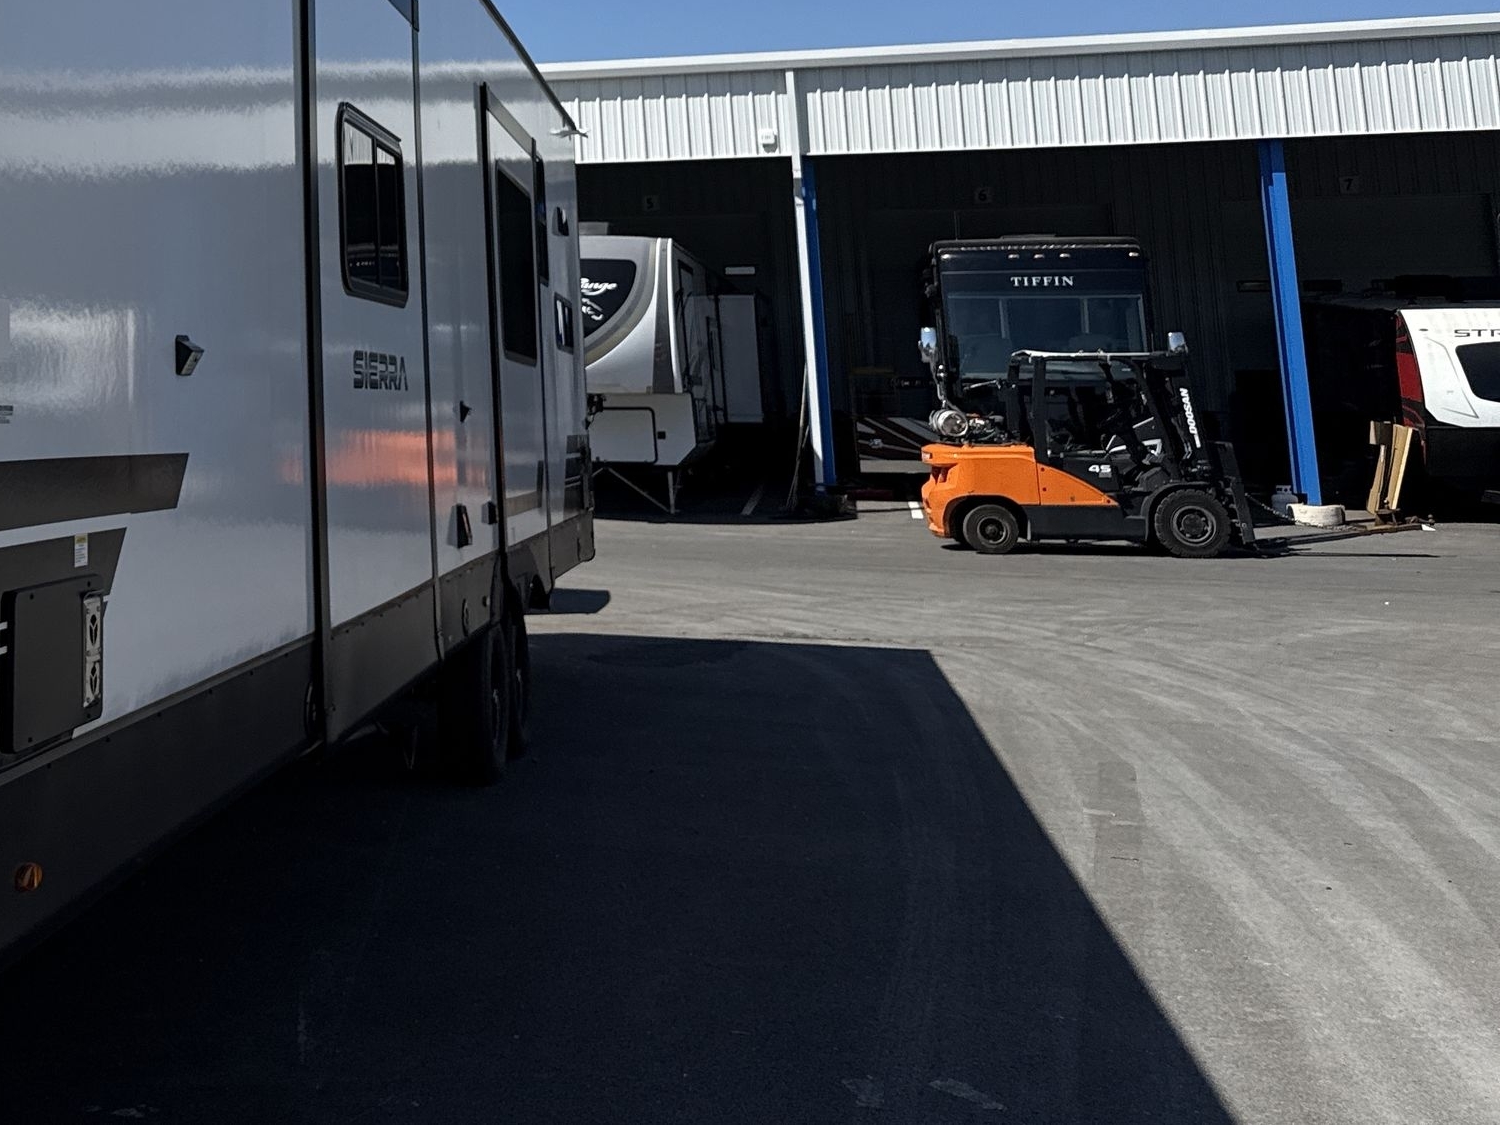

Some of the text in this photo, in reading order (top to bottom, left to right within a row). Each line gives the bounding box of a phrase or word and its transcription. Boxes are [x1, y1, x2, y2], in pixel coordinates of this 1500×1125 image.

[1010, 276, 1074, 287] TIFFIN
[353, 350, 408, 391] SIERRA
[1179, 387, 1198, 434] DOOSAN
